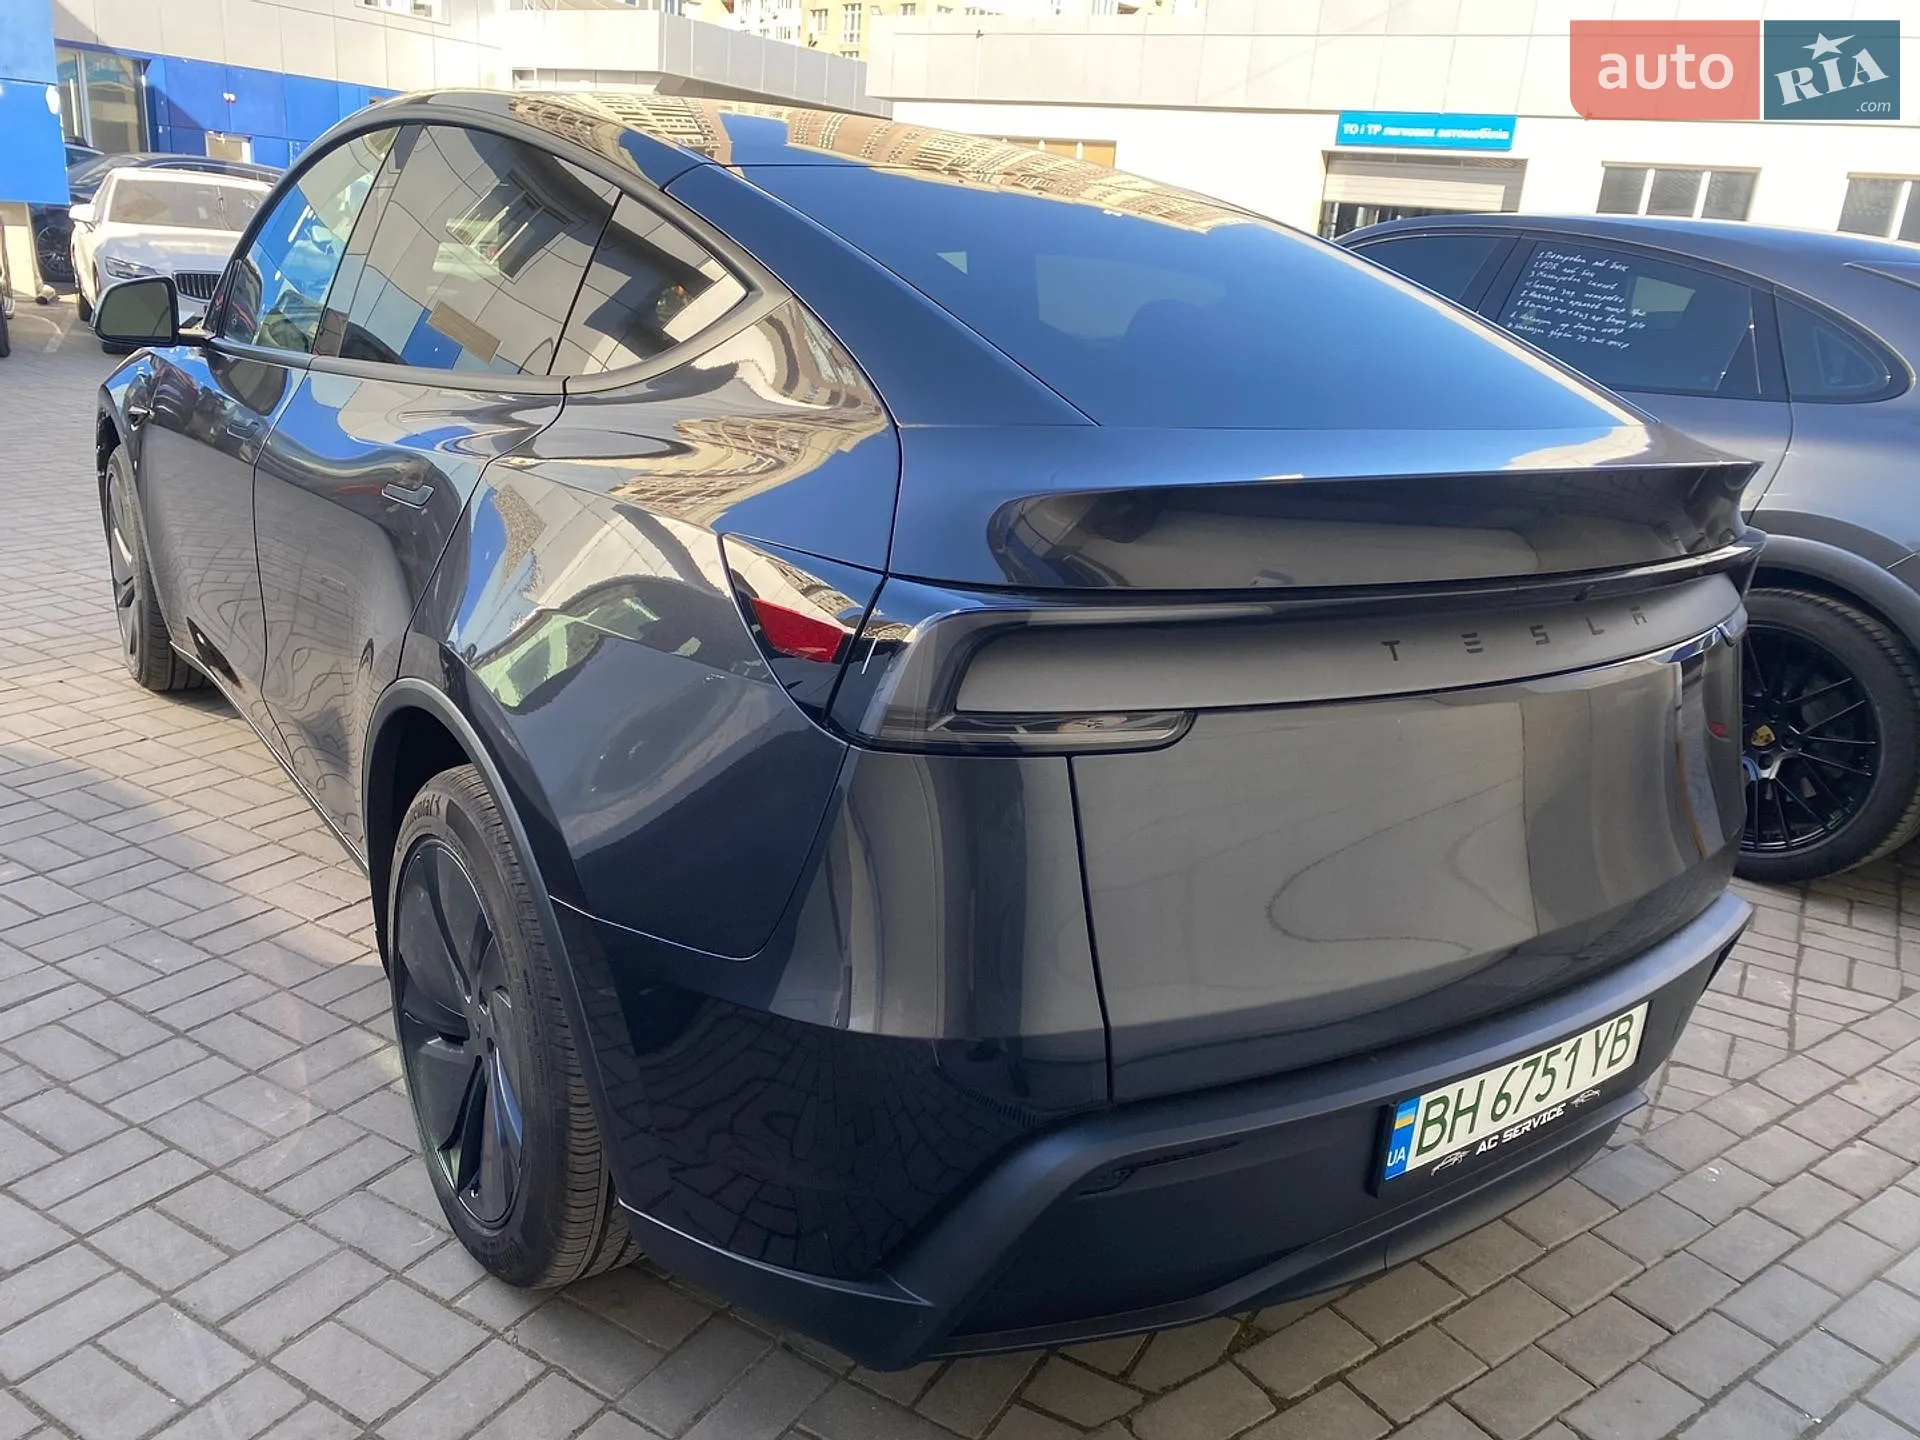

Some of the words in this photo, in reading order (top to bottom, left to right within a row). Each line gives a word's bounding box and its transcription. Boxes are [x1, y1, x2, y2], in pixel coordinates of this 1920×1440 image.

[1380, 605, 1648, 662] TESLA
[1415, 1078, 1486, 1159] BH
[1489, 1037, 1583, 1123] 6751
[1591, 1013, 1635, 1078] YB
[1475, 1135, 1500, 1156] AC
[1501, 1102, 1567, 1144] SERVICE
[1386, 1149, 1407, 1168] UA
